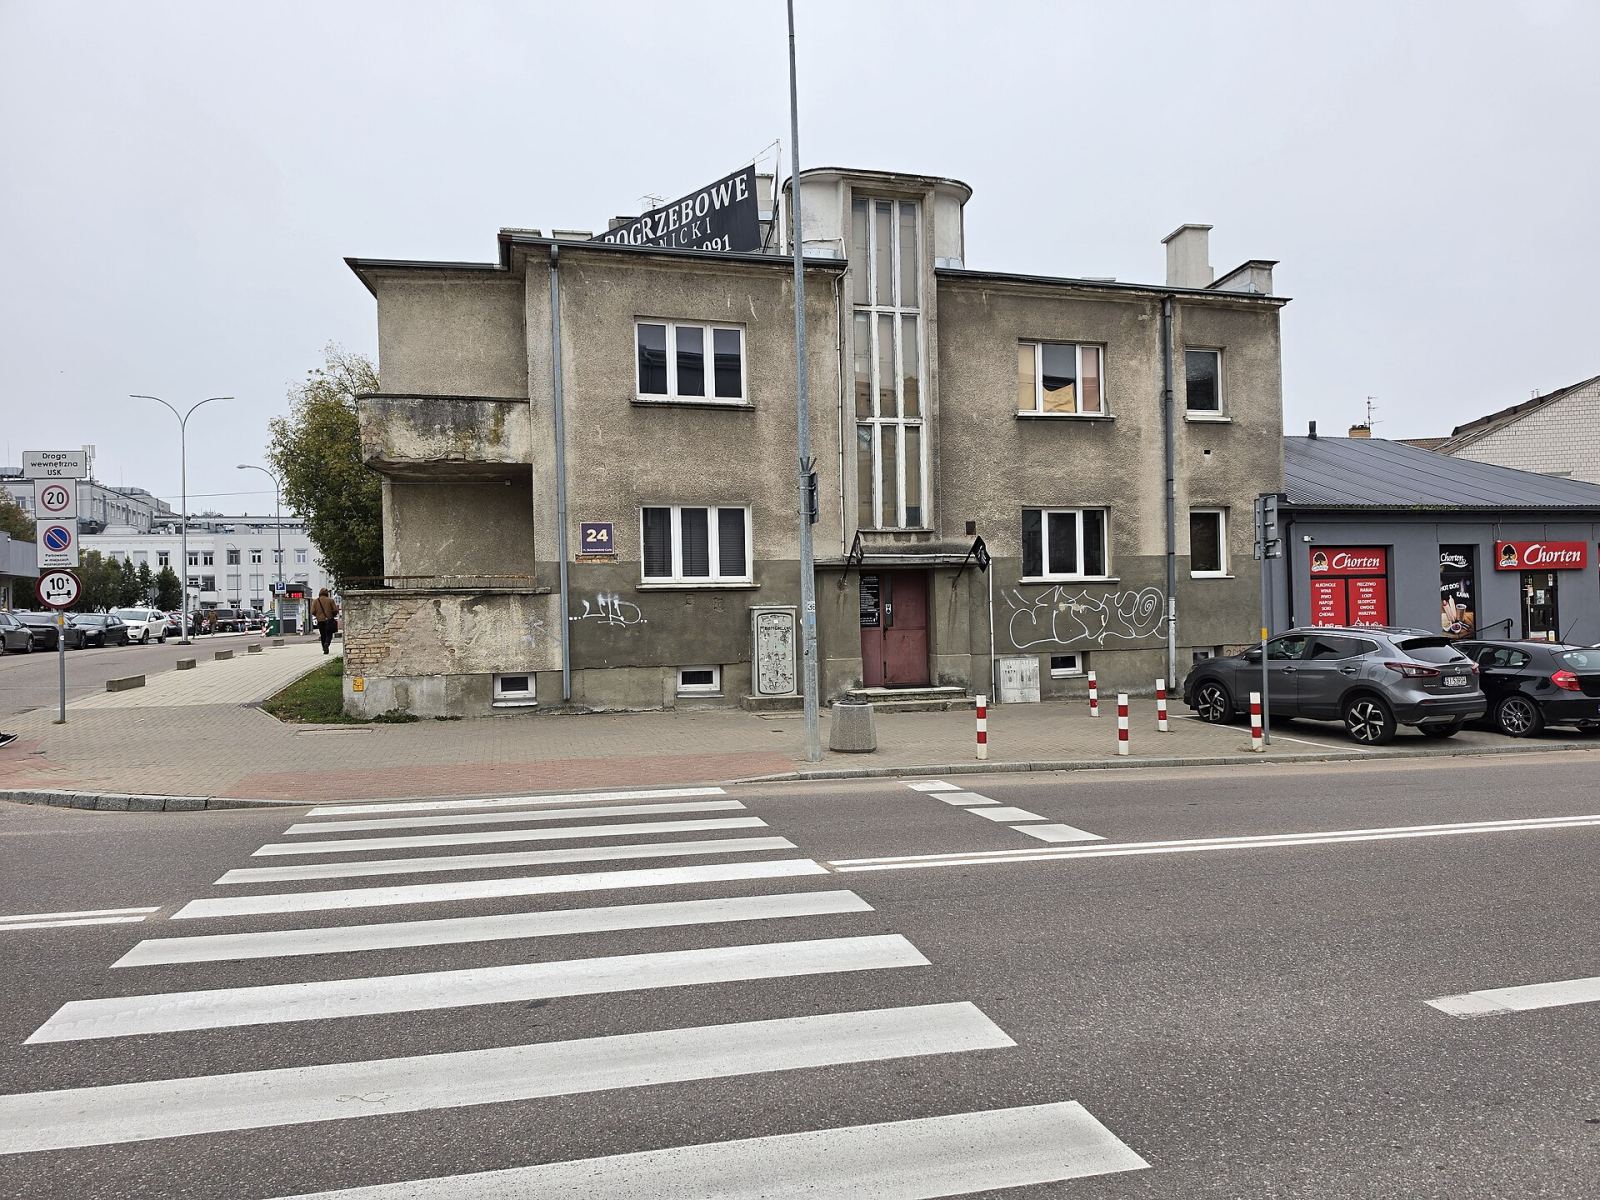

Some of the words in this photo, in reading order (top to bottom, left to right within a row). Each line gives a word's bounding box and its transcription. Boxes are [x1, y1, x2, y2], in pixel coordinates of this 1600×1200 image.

[47, 491, 65, 505] 20
[586, 529, 608, 542] 24
[1332, 553, 1380, 569] Chorten
[1523, 544, 1581, 565] Chorten
